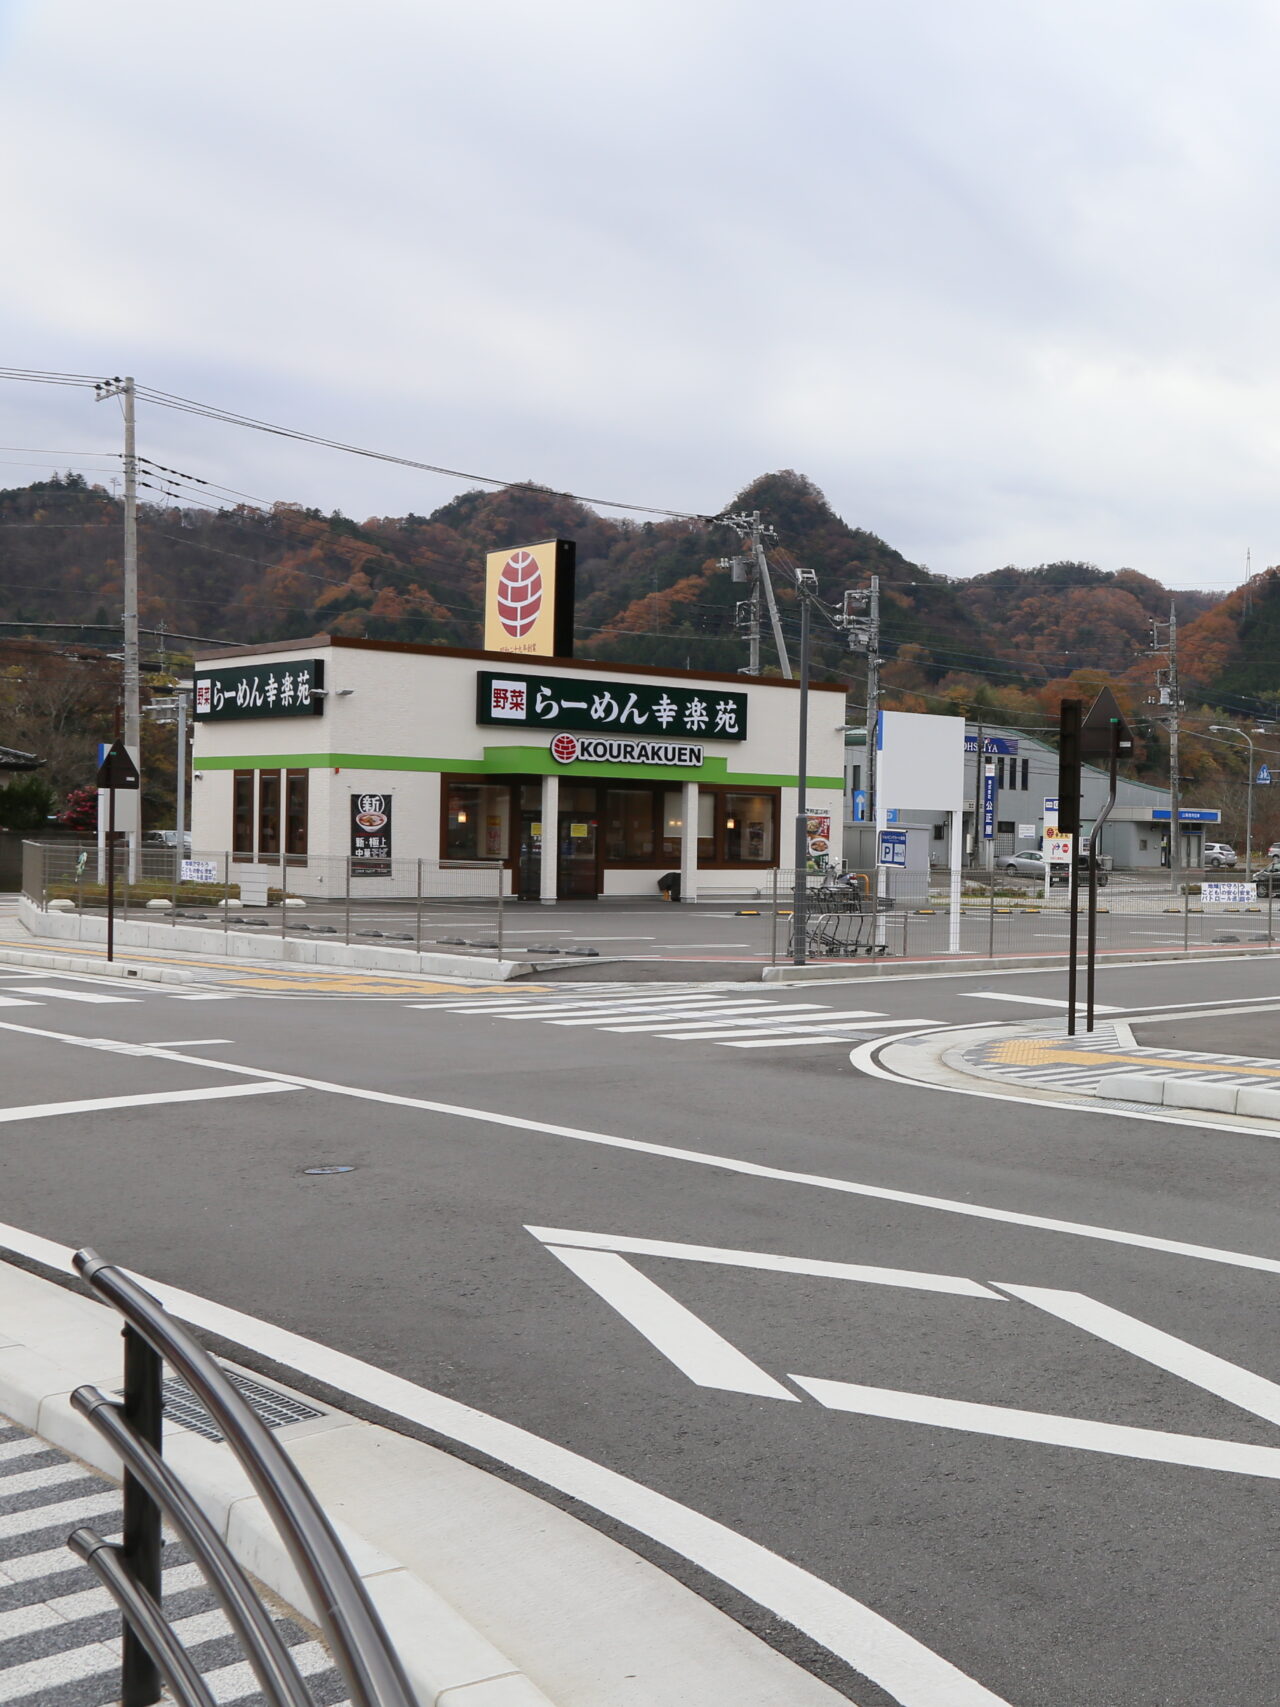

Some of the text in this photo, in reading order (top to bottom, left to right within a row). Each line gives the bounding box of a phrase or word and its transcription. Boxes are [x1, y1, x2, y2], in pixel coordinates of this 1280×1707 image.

[197, 670, 311, 711] 野菜 らーめん幸楽苑
[493, 686, 739, 734] 野菜 らーめん幸楽苑
[580, 741, 701, 764] KOURAKUEN
[884, 846, 891, 858] P
